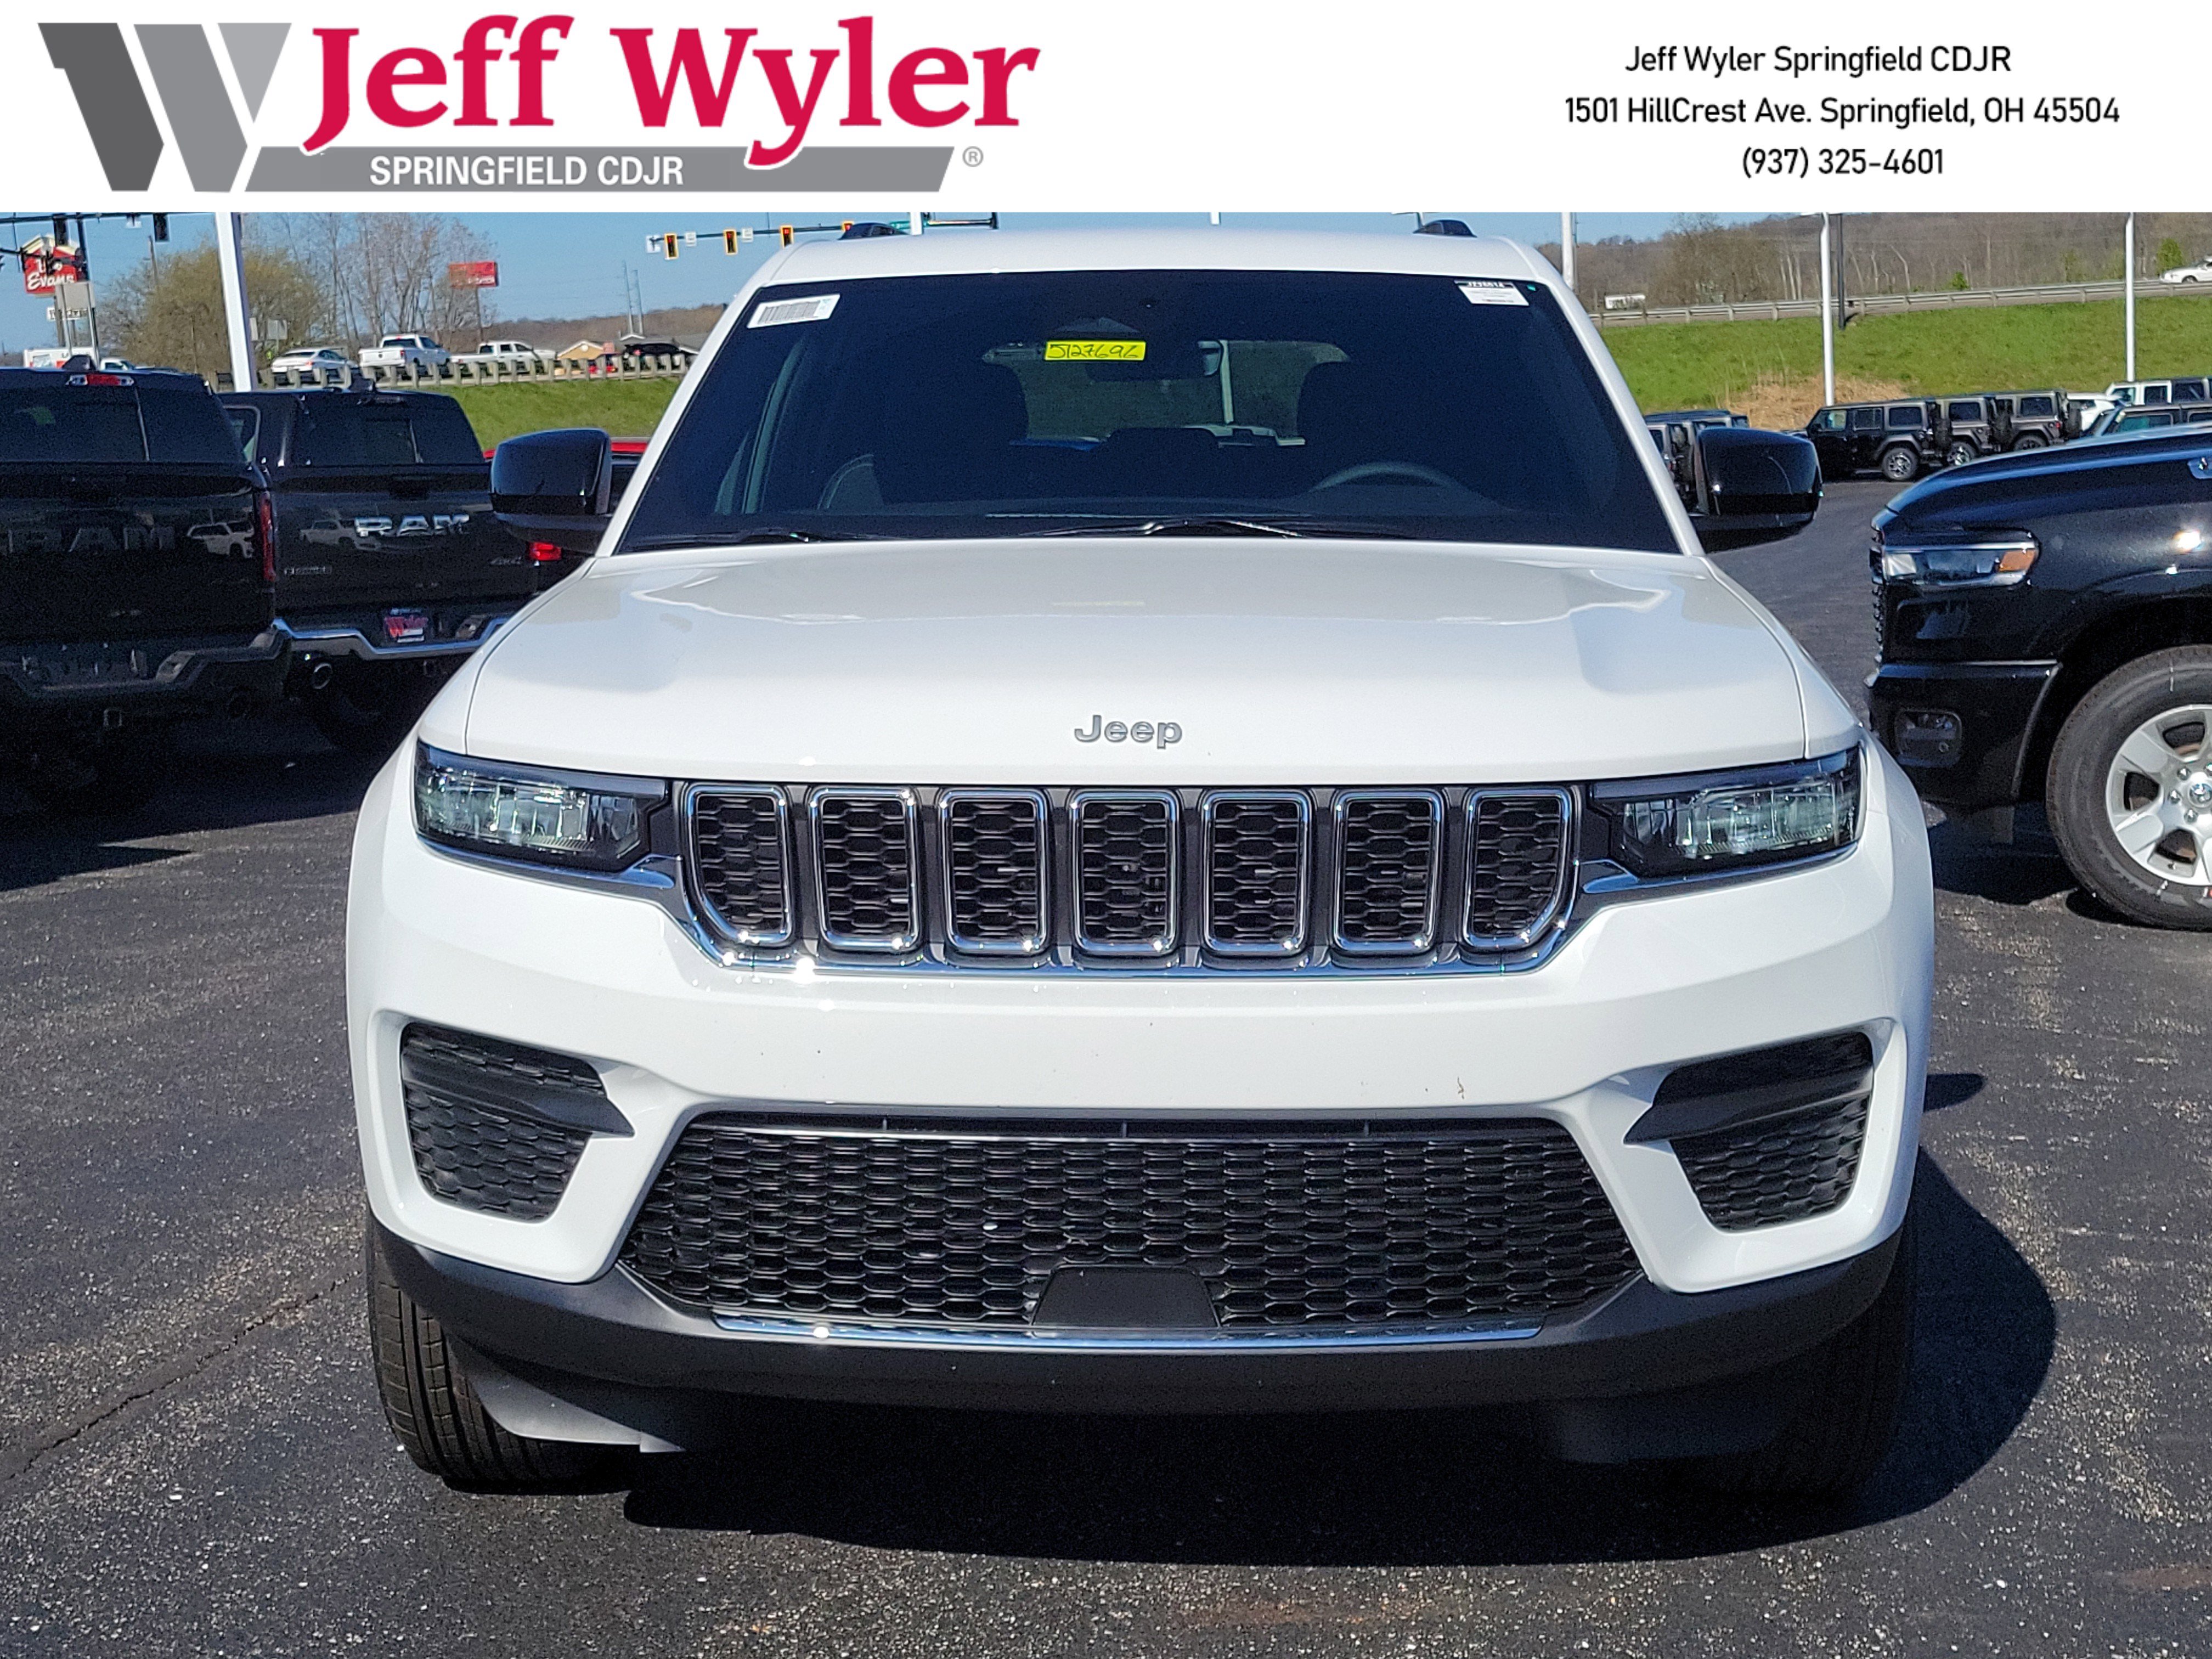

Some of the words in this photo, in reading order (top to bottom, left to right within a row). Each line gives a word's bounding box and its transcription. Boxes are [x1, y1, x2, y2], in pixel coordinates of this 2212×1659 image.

[27, 272, 75, 291] Evans
[354, 514, 470, 538] RAM
[1074, 714, 1183, 749] Jeep
